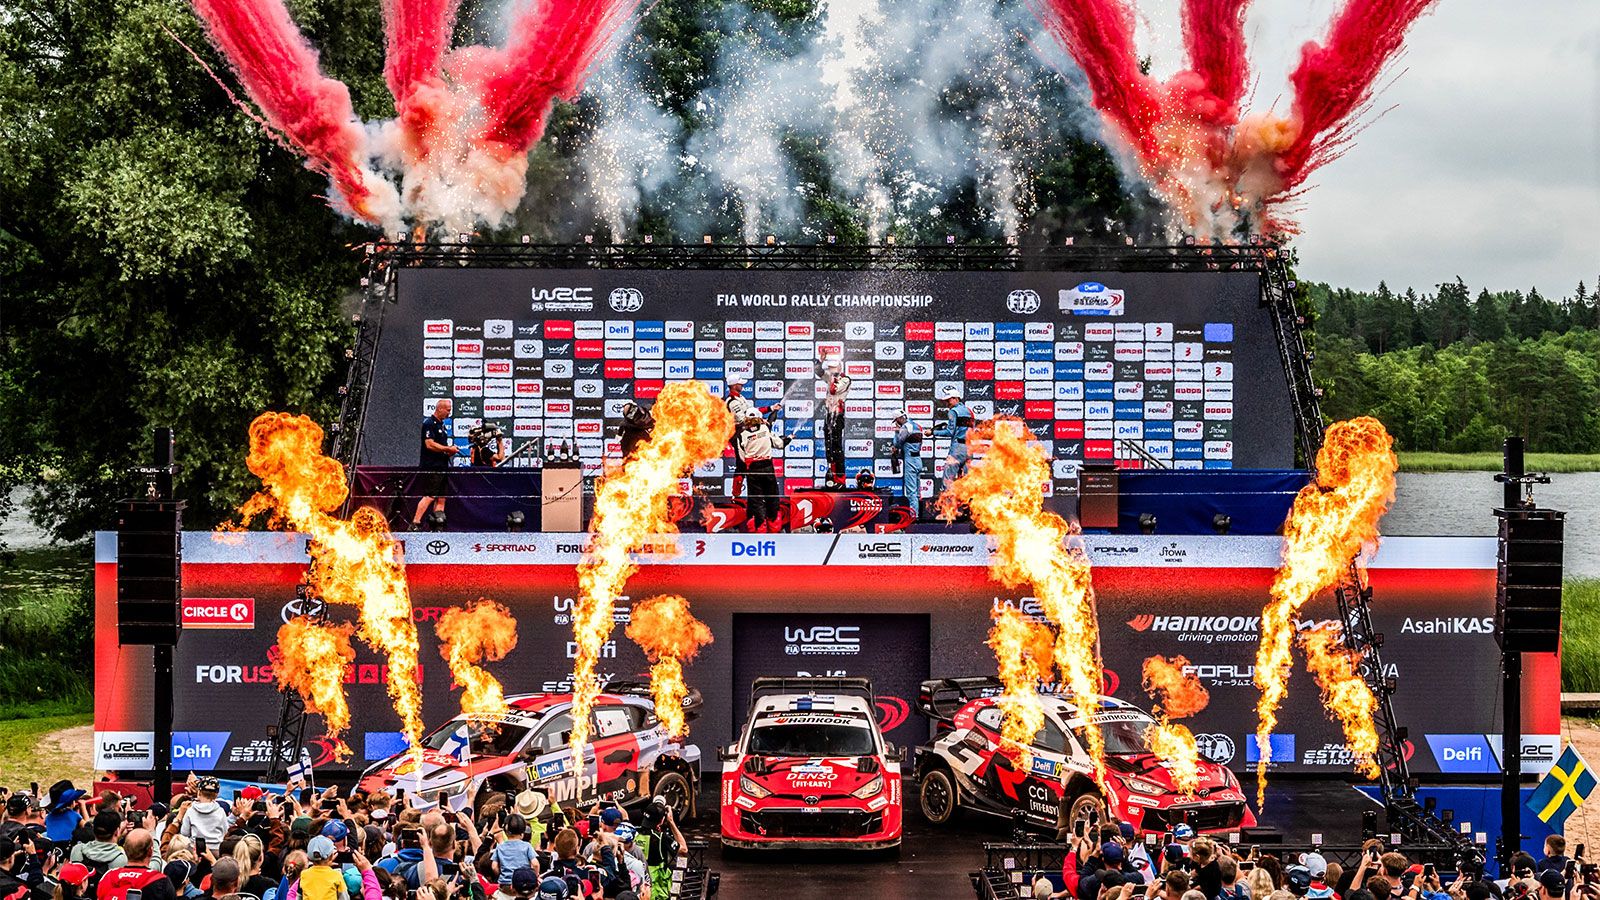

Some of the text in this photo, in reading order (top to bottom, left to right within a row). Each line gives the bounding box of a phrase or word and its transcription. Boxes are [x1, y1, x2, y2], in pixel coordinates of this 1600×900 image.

[716, 294, 933, 306] FIA WORLD RALLY CHAMPIONSHIP
[796, 499, 813, 524] 1
[712, 512, 726, 532] 2
[732, 542, 776, 556] Delfi
[858, 543, 901, 552] WRC
[184, 606, 244, 617] CIRCLE K
[1401, 618, 1494, 634] AsahiKAS
[785, 626, 860, 642] WRC
[1178, 633, 1258, 643] driving emotion
[196, 665, 272, 683] FORUS
[104, 742, 149, 752] WRC
[174, 744, 211, 758] Delfi
[1444, 747, 1482, 760] Delfi
[1520, 745, 1553, 755] RC
[542, 764, 559, 774] Delfi
[1035, 760, 1052, 771] Delfi
[527, 766, 538, 781] 16
